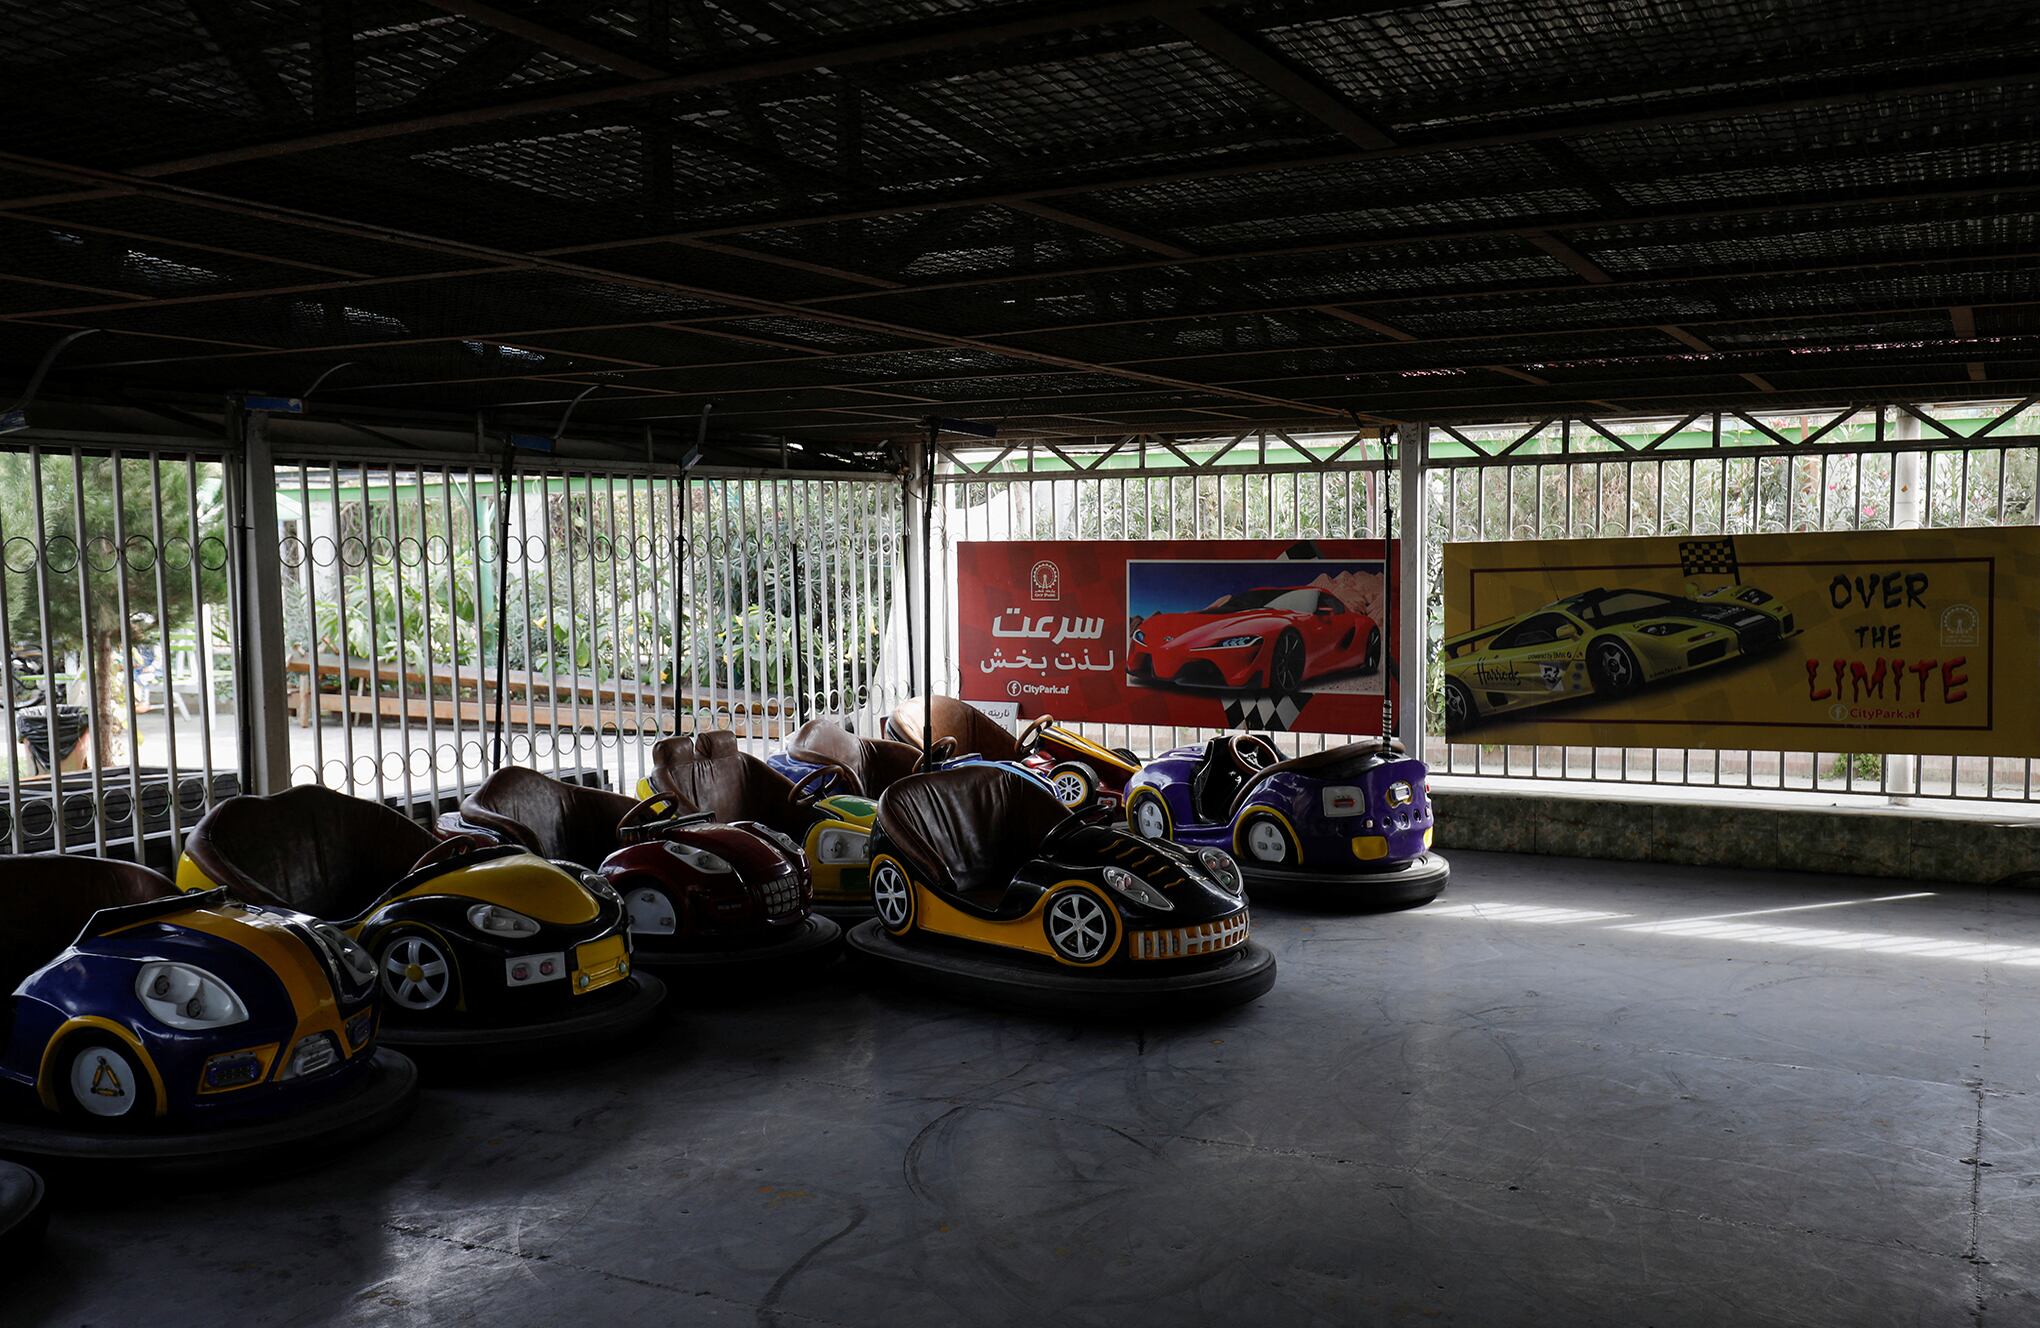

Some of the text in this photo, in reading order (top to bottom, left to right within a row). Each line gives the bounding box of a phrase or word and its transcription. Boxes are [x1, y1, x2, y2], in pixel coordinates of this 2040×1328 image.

[1829, 571, 1929, 610] OVER
[991, 607, 1105, 645] سرعت
[1855, 624, 1902, 649] THE
[980, 647, 1115, 677] لذت بخش
[1473, 656, 1521, 686] Harrods
[1023, 684, 1070, 695] CityPark.af
[1806, 656, 1969, 704] LIMITE
[1850, 708, 1921, 720] CityPark.af
